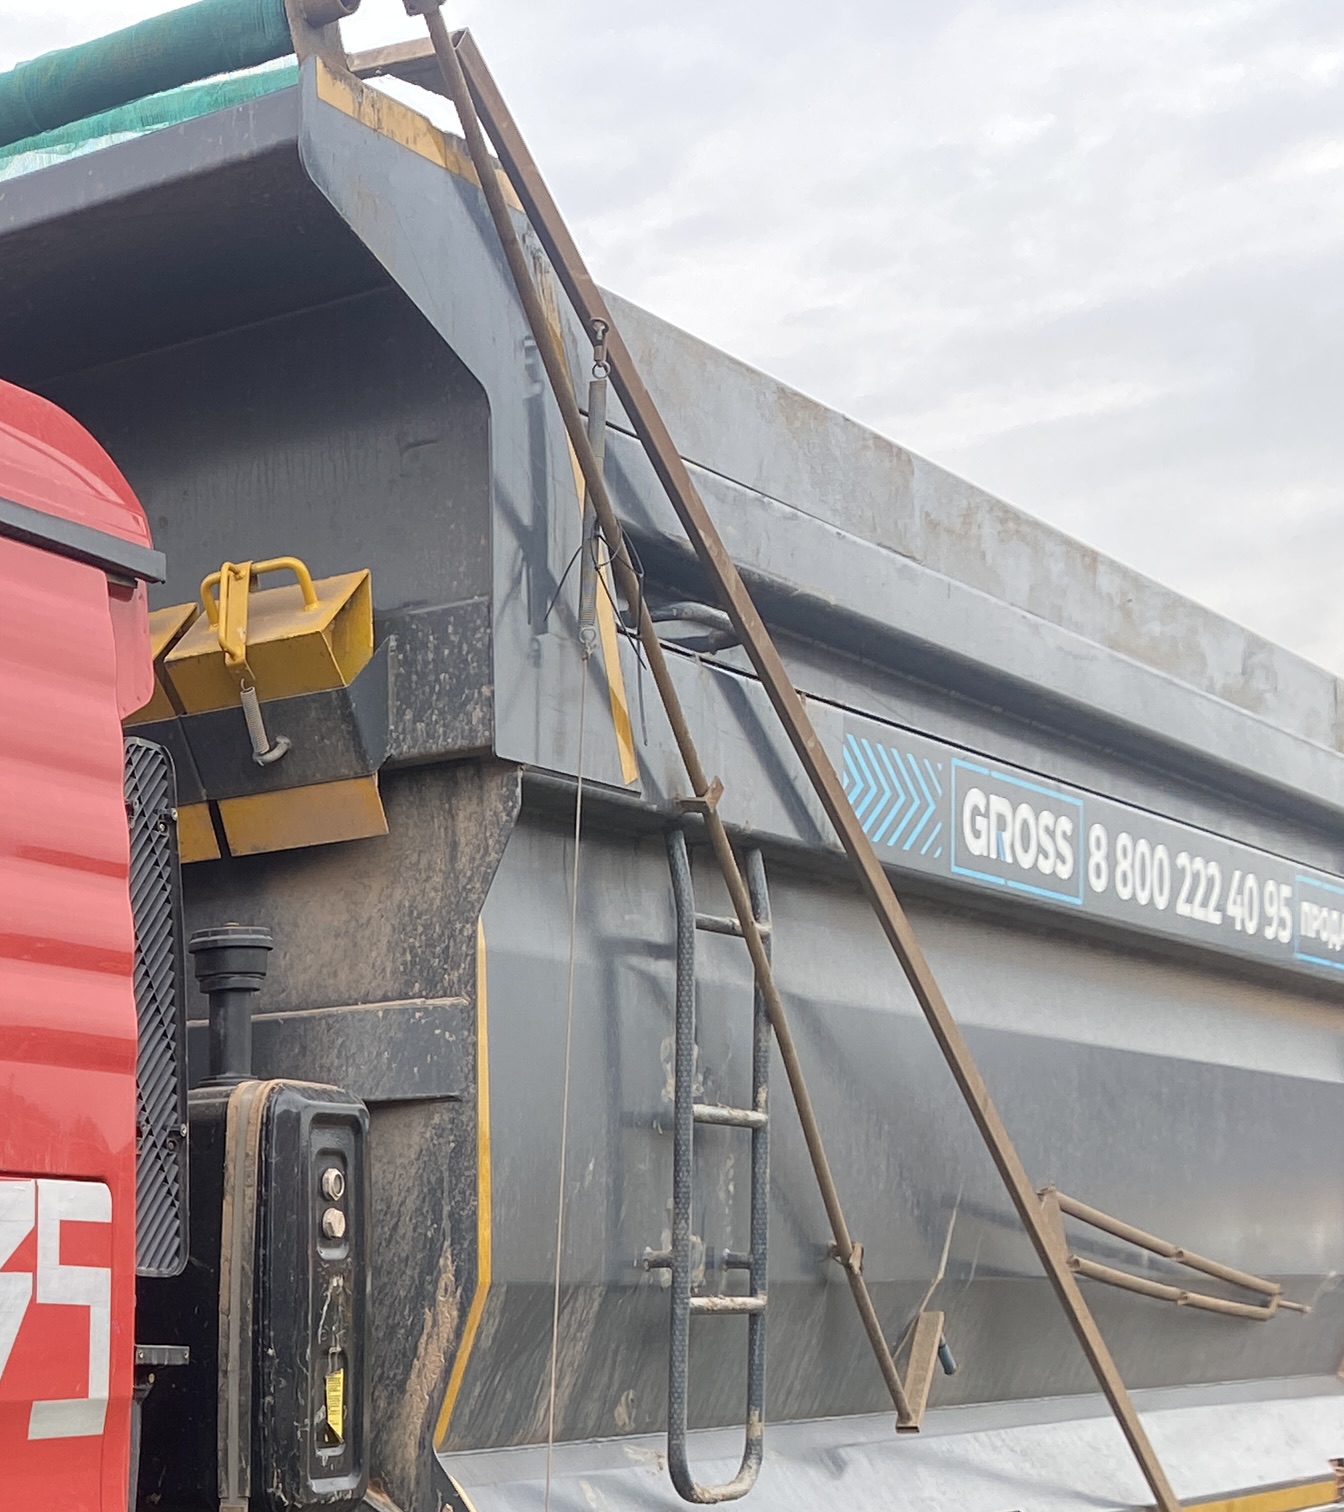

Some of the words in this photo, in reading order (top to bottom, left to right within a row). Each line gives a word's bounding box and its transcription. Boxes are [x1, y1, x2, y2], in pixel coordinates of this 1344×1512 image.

[963, 787, 1074, 879] GROSS
[1088, 824, 1109, 893] 8
[1115, 832, 1171, 910] 800
[1175, 851, 1223, 925] 222
[1227, 870, 1260, 935] 40
[1263, 879, 1293, 944] 95
[1300, 901, 1344, 951] ПРОД
